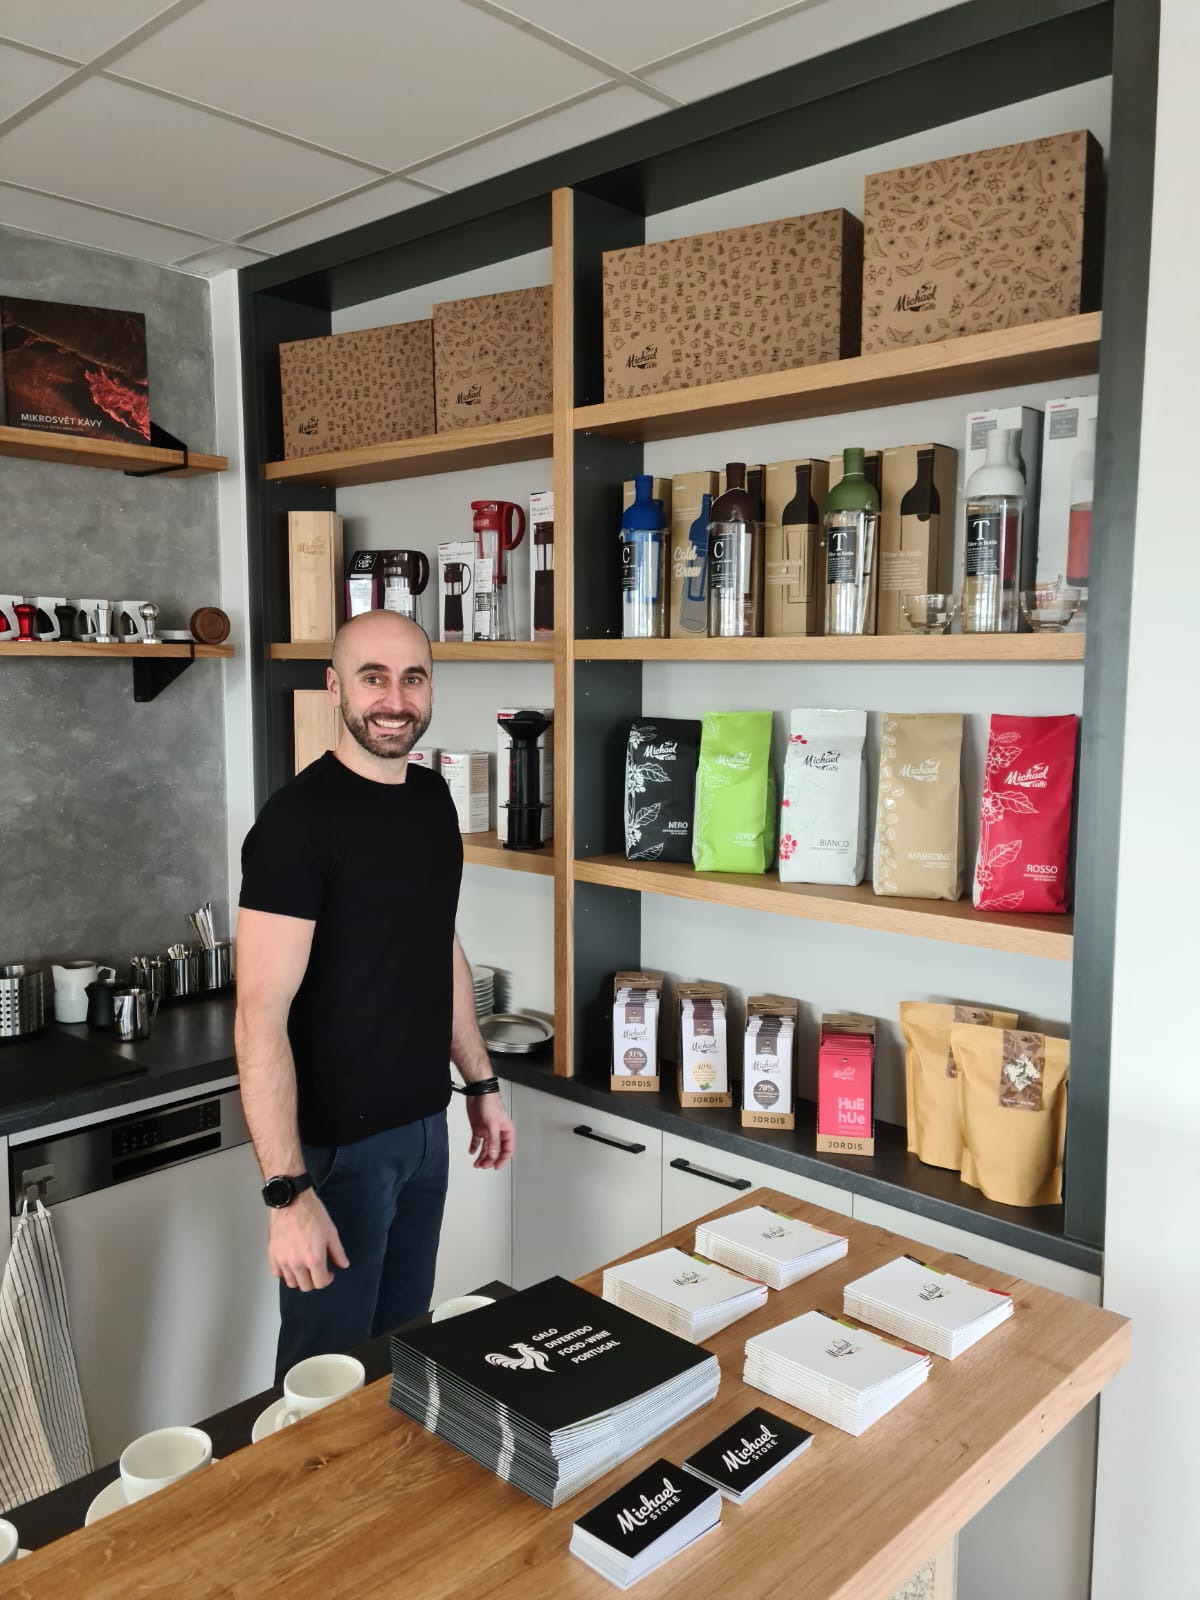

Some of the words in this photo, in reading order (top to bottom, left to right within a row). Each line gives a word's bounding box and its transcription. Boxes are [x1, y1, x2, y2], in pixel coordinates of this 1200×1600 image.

[893, 284, 937, 312] Michael
[973, 520, 990, 540] T
[713, 541, 725, 558] C
[832, 532, 848, 551] T
[622, 547, 631, 563] C
[674, 545, 698, 562] Cold
[674, 562, 702, 578] Brew
[643, 742, 678, 758] Michael
[804, 753, 841, 768] Michael
[899, 760, 941, 777] Michael
[1004, 766, 1049, 785] Michael
[668, 821, 688, 829] NERO
[819, 838, 850, 848] BIANCO
[1026, 864, 1058, 874] ROSSO
[621, 1080, 652, 1088] JORDIS
[693, 1096, 724, 1104] JORDIS
[838, 1097, 865, 1111] HuE
[752, 1115, 785, 1125] JORDIS
[838, 1111, 866, 1125] hUe
[828, 1140, 863, 1151] JORDIS
[532, 1328, 558, 1341] GALO
[544, 1325, 593, 1349] DIVERTIDO
[571, 1340, 621, 1364] PORTUGAL
[721, 1424, 778, 1473] Michael
[751, 1439, 778, 1461] STORE
[616, 1477, 682, 1535] Michael
[650, 1496, 681, 1521] STORE
